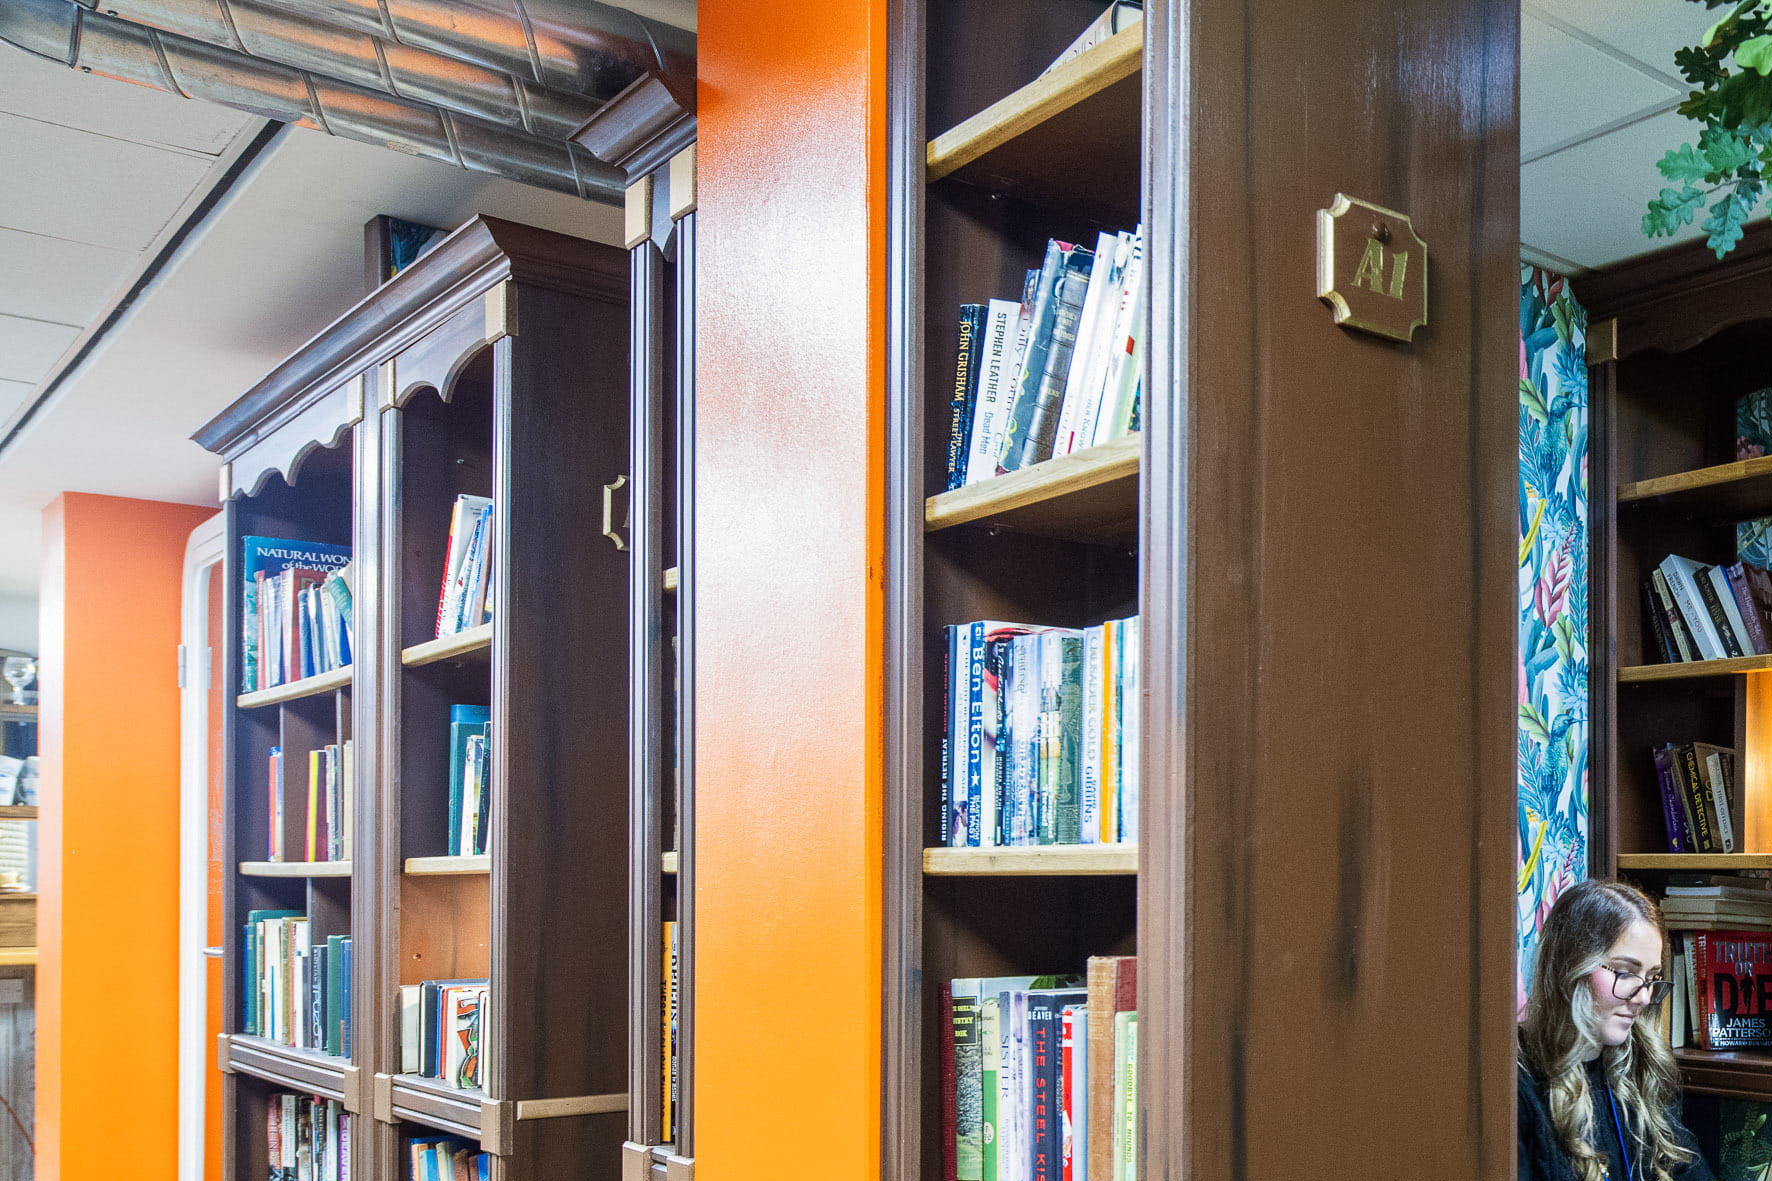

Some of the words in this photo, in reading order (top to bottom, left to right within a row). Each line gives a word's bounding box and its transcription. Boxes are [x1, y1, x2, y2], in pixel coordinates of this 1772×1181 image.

[960, 320, 971, 350] JOHN
[991, 312, 1007, 360] STEPHEN
[954, 353, 969, 401] GRISHAM
[985, 359, 1001, 403] LEATHER
[952, 408, 961, 437] STREET
[984, 412, 993, 436] Dead
[948, 438, 958, 473] LAWYER
[257, 547, 319, 562] NATURAL
[282, 561, 294, 570] of
[971, 646, 983, 692] Ben
[1086, 635, 1099, 711] CRUSADER
[970, 701, 983, 764] Elton
[1085, 716, 1098, 761] GOLD
[1084, 766, 1094, 824] GIBBINS
[1686, 752, 1700, 793] CHEMICAL
[1694, 793, 1709, 837] DETECTIVE
[968, 815, 976, 840] PAST
[1735, 961, 1753, 977] OR
[312, 990, 321, 1037] PUZO
[1028, 1011, 1052, 1020] DEAVER
[1726, 1018, 1757, 1028] JAMES
[1036, 1027, 1046, 1068] THE
[1721, 1040, 1749, 1048] HOWARD
[1001, 1034, 1010, 1104] SISTER
[1036, 1078, 1046, 1144] STEEL
